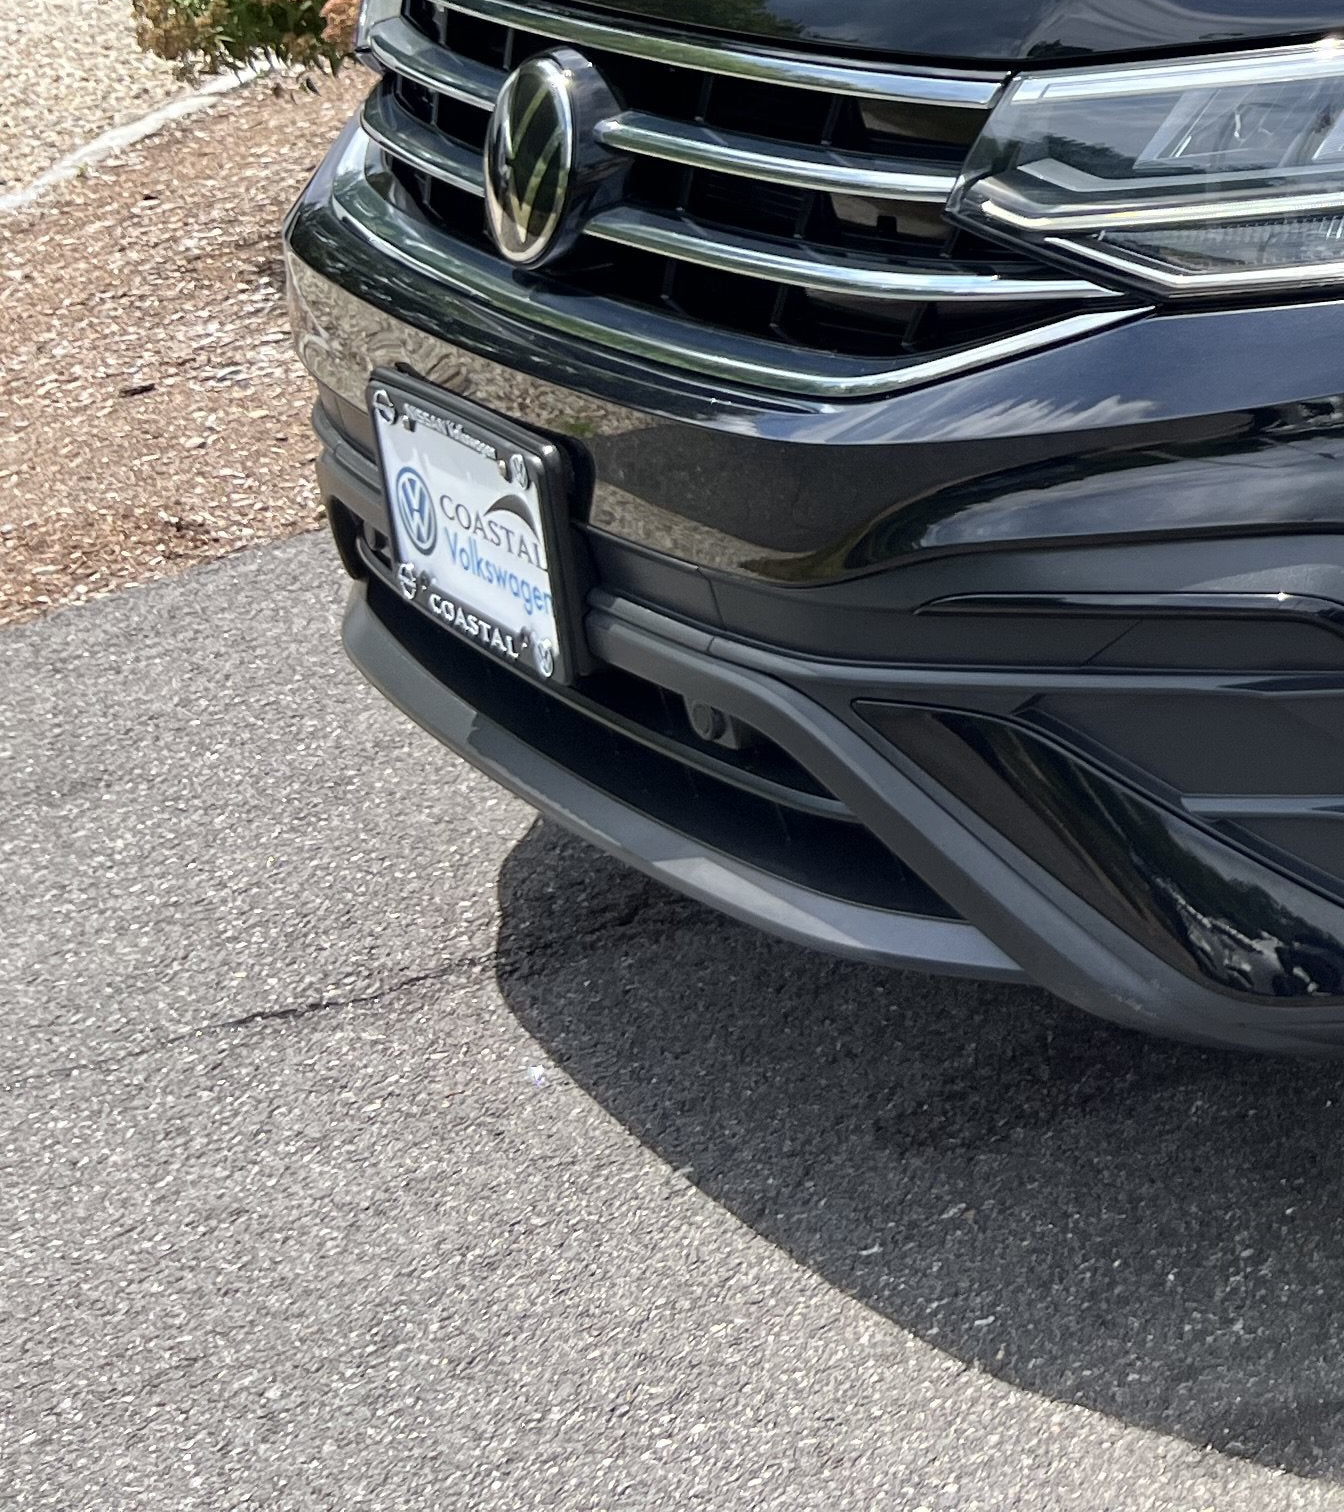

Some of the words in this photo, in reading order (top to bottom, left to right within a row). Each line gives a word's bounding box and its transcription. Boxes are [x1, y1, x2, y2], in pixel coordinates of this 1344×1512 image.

[439, 494, 549, 571] COASTAL
[444, 526, 553, 616] Volkswagen
[430, 593, 519, 659] COASTAL
